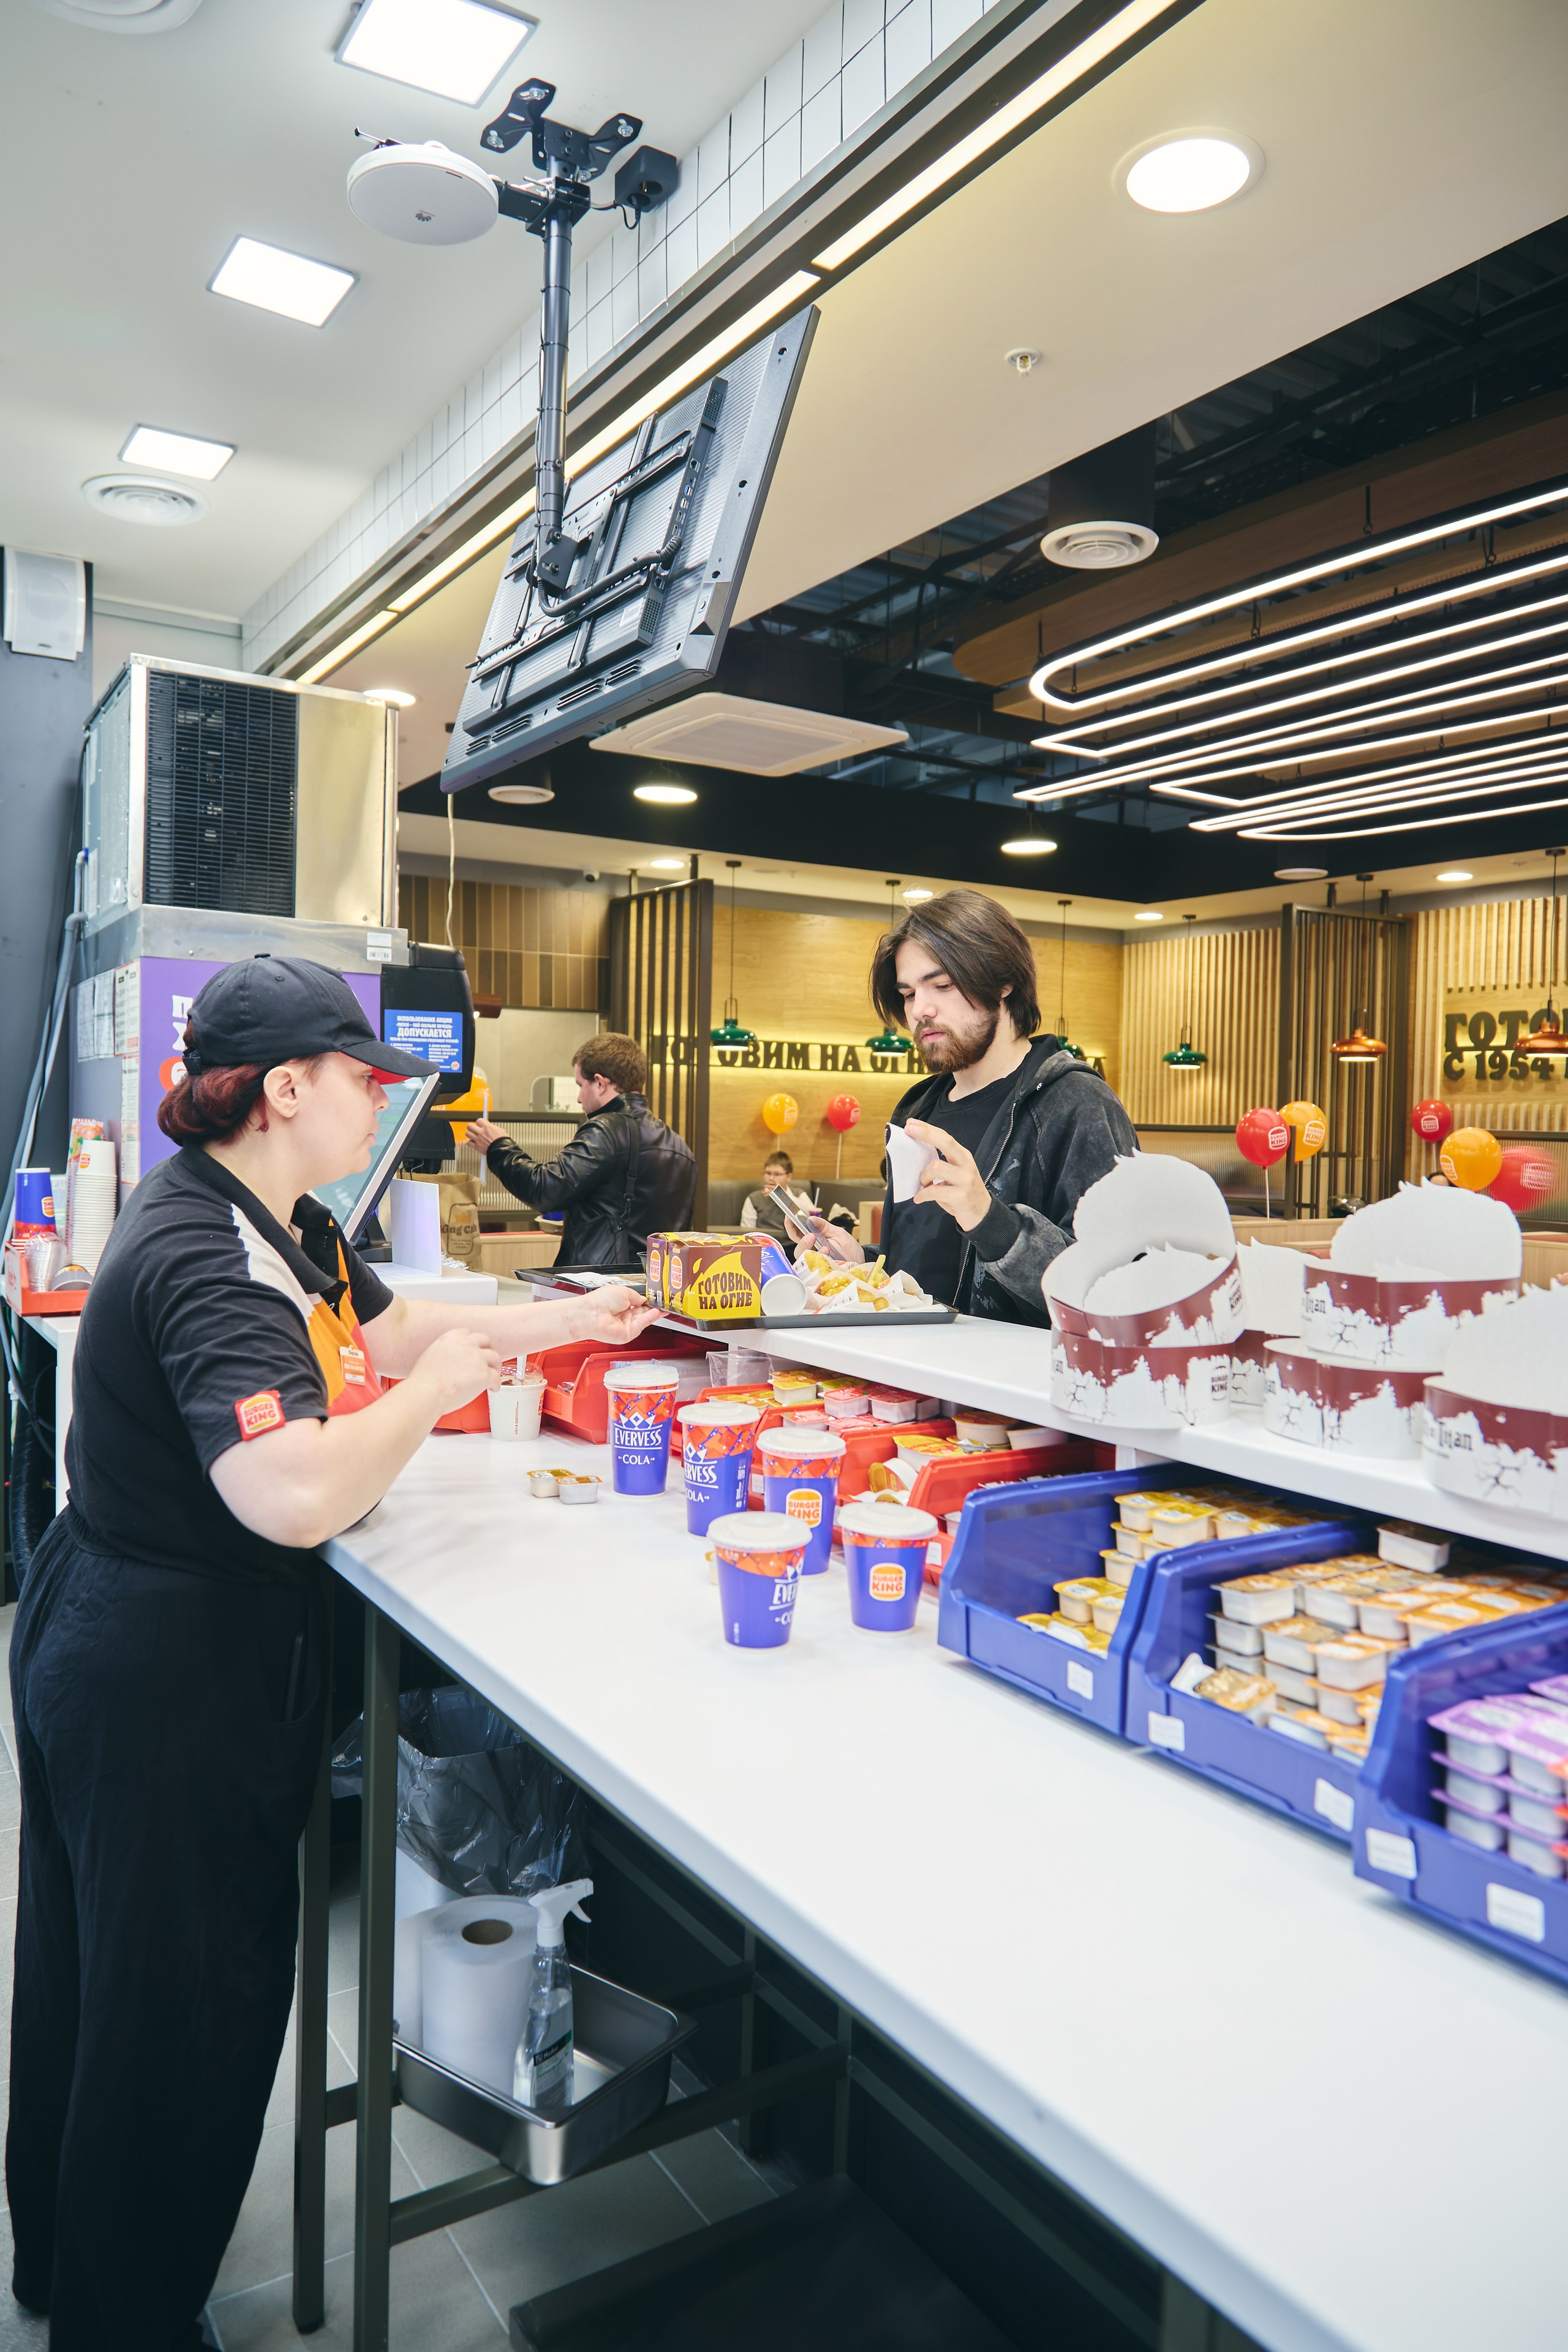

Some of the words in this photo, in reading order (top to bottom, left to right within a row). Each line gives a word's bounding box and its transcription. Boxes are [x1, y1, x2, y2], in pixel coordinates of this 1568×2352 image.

[398, 1027, 452, 1038] ДОПУСКАЕТСЯ
[1445, 1009, 1568, 1052] ГОТО
[650, 1035, 809, 1070] ГООВИМ
[821, 1044, 861, 1072] НА
[1444, 1050, 1465, 1081] С
[1476, 1049, 1555, 1080] 1954
[1305, 1133, 1323, 1142] KING
[650, 1265, 660, 1276] KING
[671, 1272, 682, 1283] KING
[698, 1272, 752, 1295] ГОТОВИМ
[699, 1296, 717, 1310] НА
[720, 1292, 753, 1309] ОГНЕ
[244, 1403, 274, 1418] BURGER
[246, 1409, 276, 1428] KING
[614, 1427, 662, 1447] EVERVESS
[622, 1454, 650, 1465] COLA
[685, 1463, 717, 1484] ERVESS
[788, 1509, 820, 1520] KING
[872, 1582, 903, 1592] KING
[781, 1610, 793, 1625] CO
